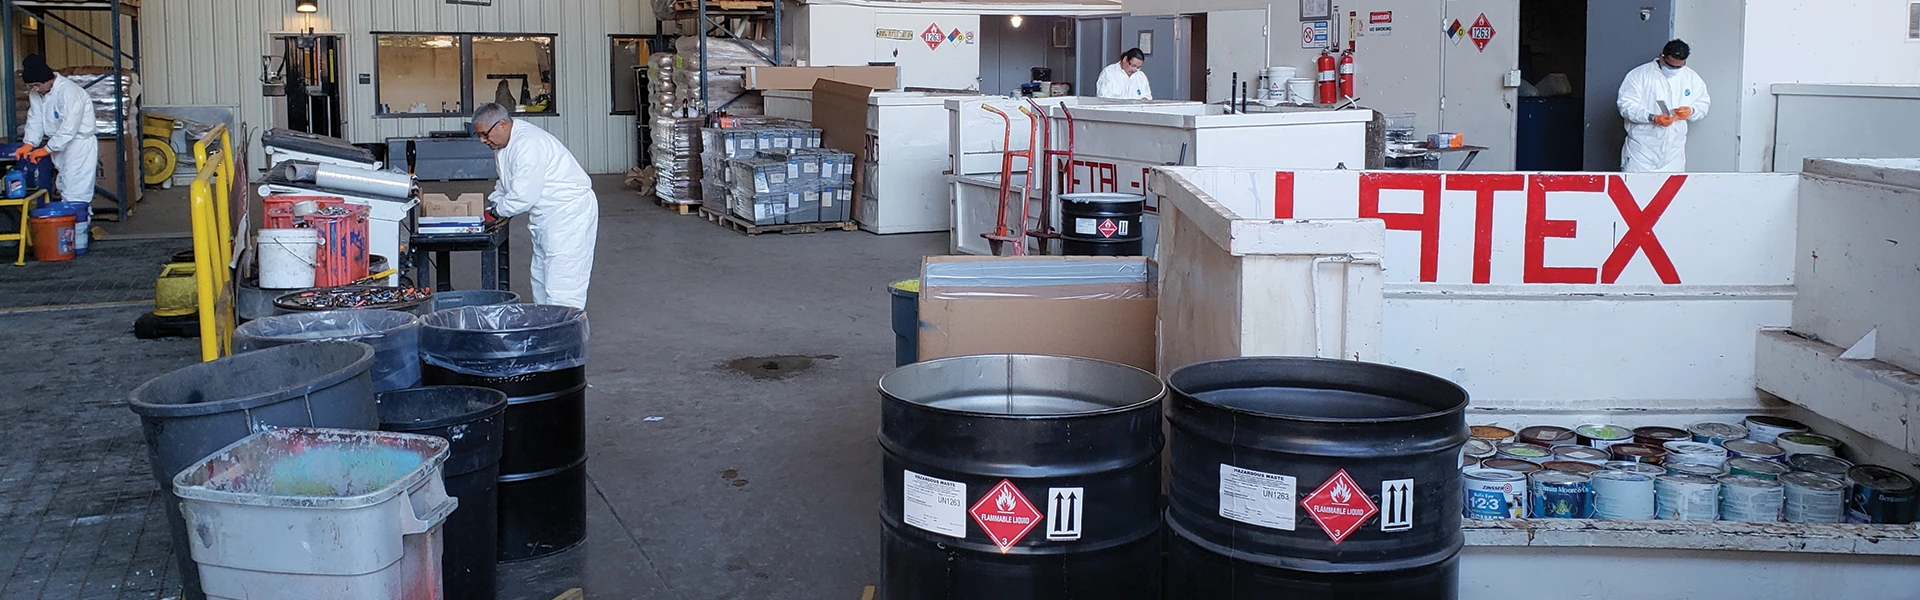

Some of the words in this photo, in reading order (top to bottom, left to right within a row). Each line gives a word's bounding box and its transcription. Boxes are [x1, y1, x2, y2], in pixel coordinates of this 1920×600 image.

[926, 33, 941, 42] 1263
[1473, 28, 1490, 39] 1263
[1233, 468, 1265, 478] HAZARDOUS
[915, 474, 939, 484] HAZARDOUS
[1262, 490, 1290, 500] UN1263
[937, 496, 961, 507] UN1263
[1313, 505, 1347, 515] FLAMMABLE
[1347, 508, 1364, 516] LIQUID
[981, 513, 1013, 524] FLAMMABLE
[1013, 516, 1030, 525] LIQUID
[1334, 529, 1340, 537] 3
[1002, 537, 1008, 545] 3
